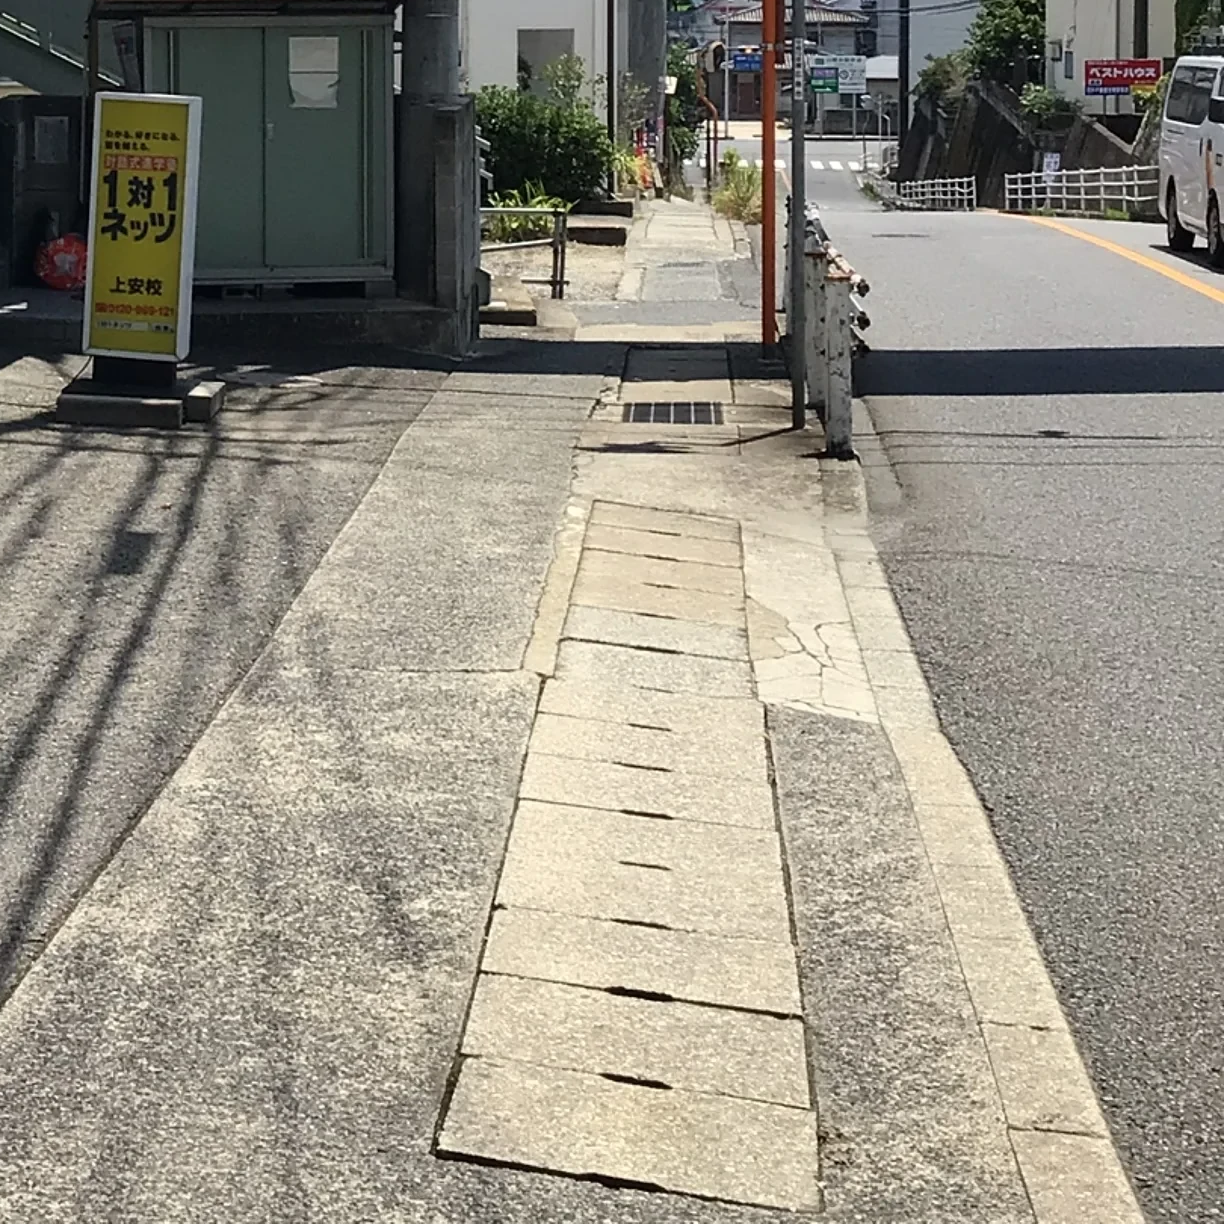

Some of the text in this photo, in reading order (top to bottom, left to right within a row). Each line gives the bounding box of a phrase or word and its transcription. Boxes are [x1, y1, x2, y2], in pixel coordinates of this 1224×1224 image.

[1089, 67, 1156, 78] ベストハウス
[103, 170, 177, 211] 1対1
[101, 208, 177, 243] ネッツ
[109, 276, 163, 295] 上安校
